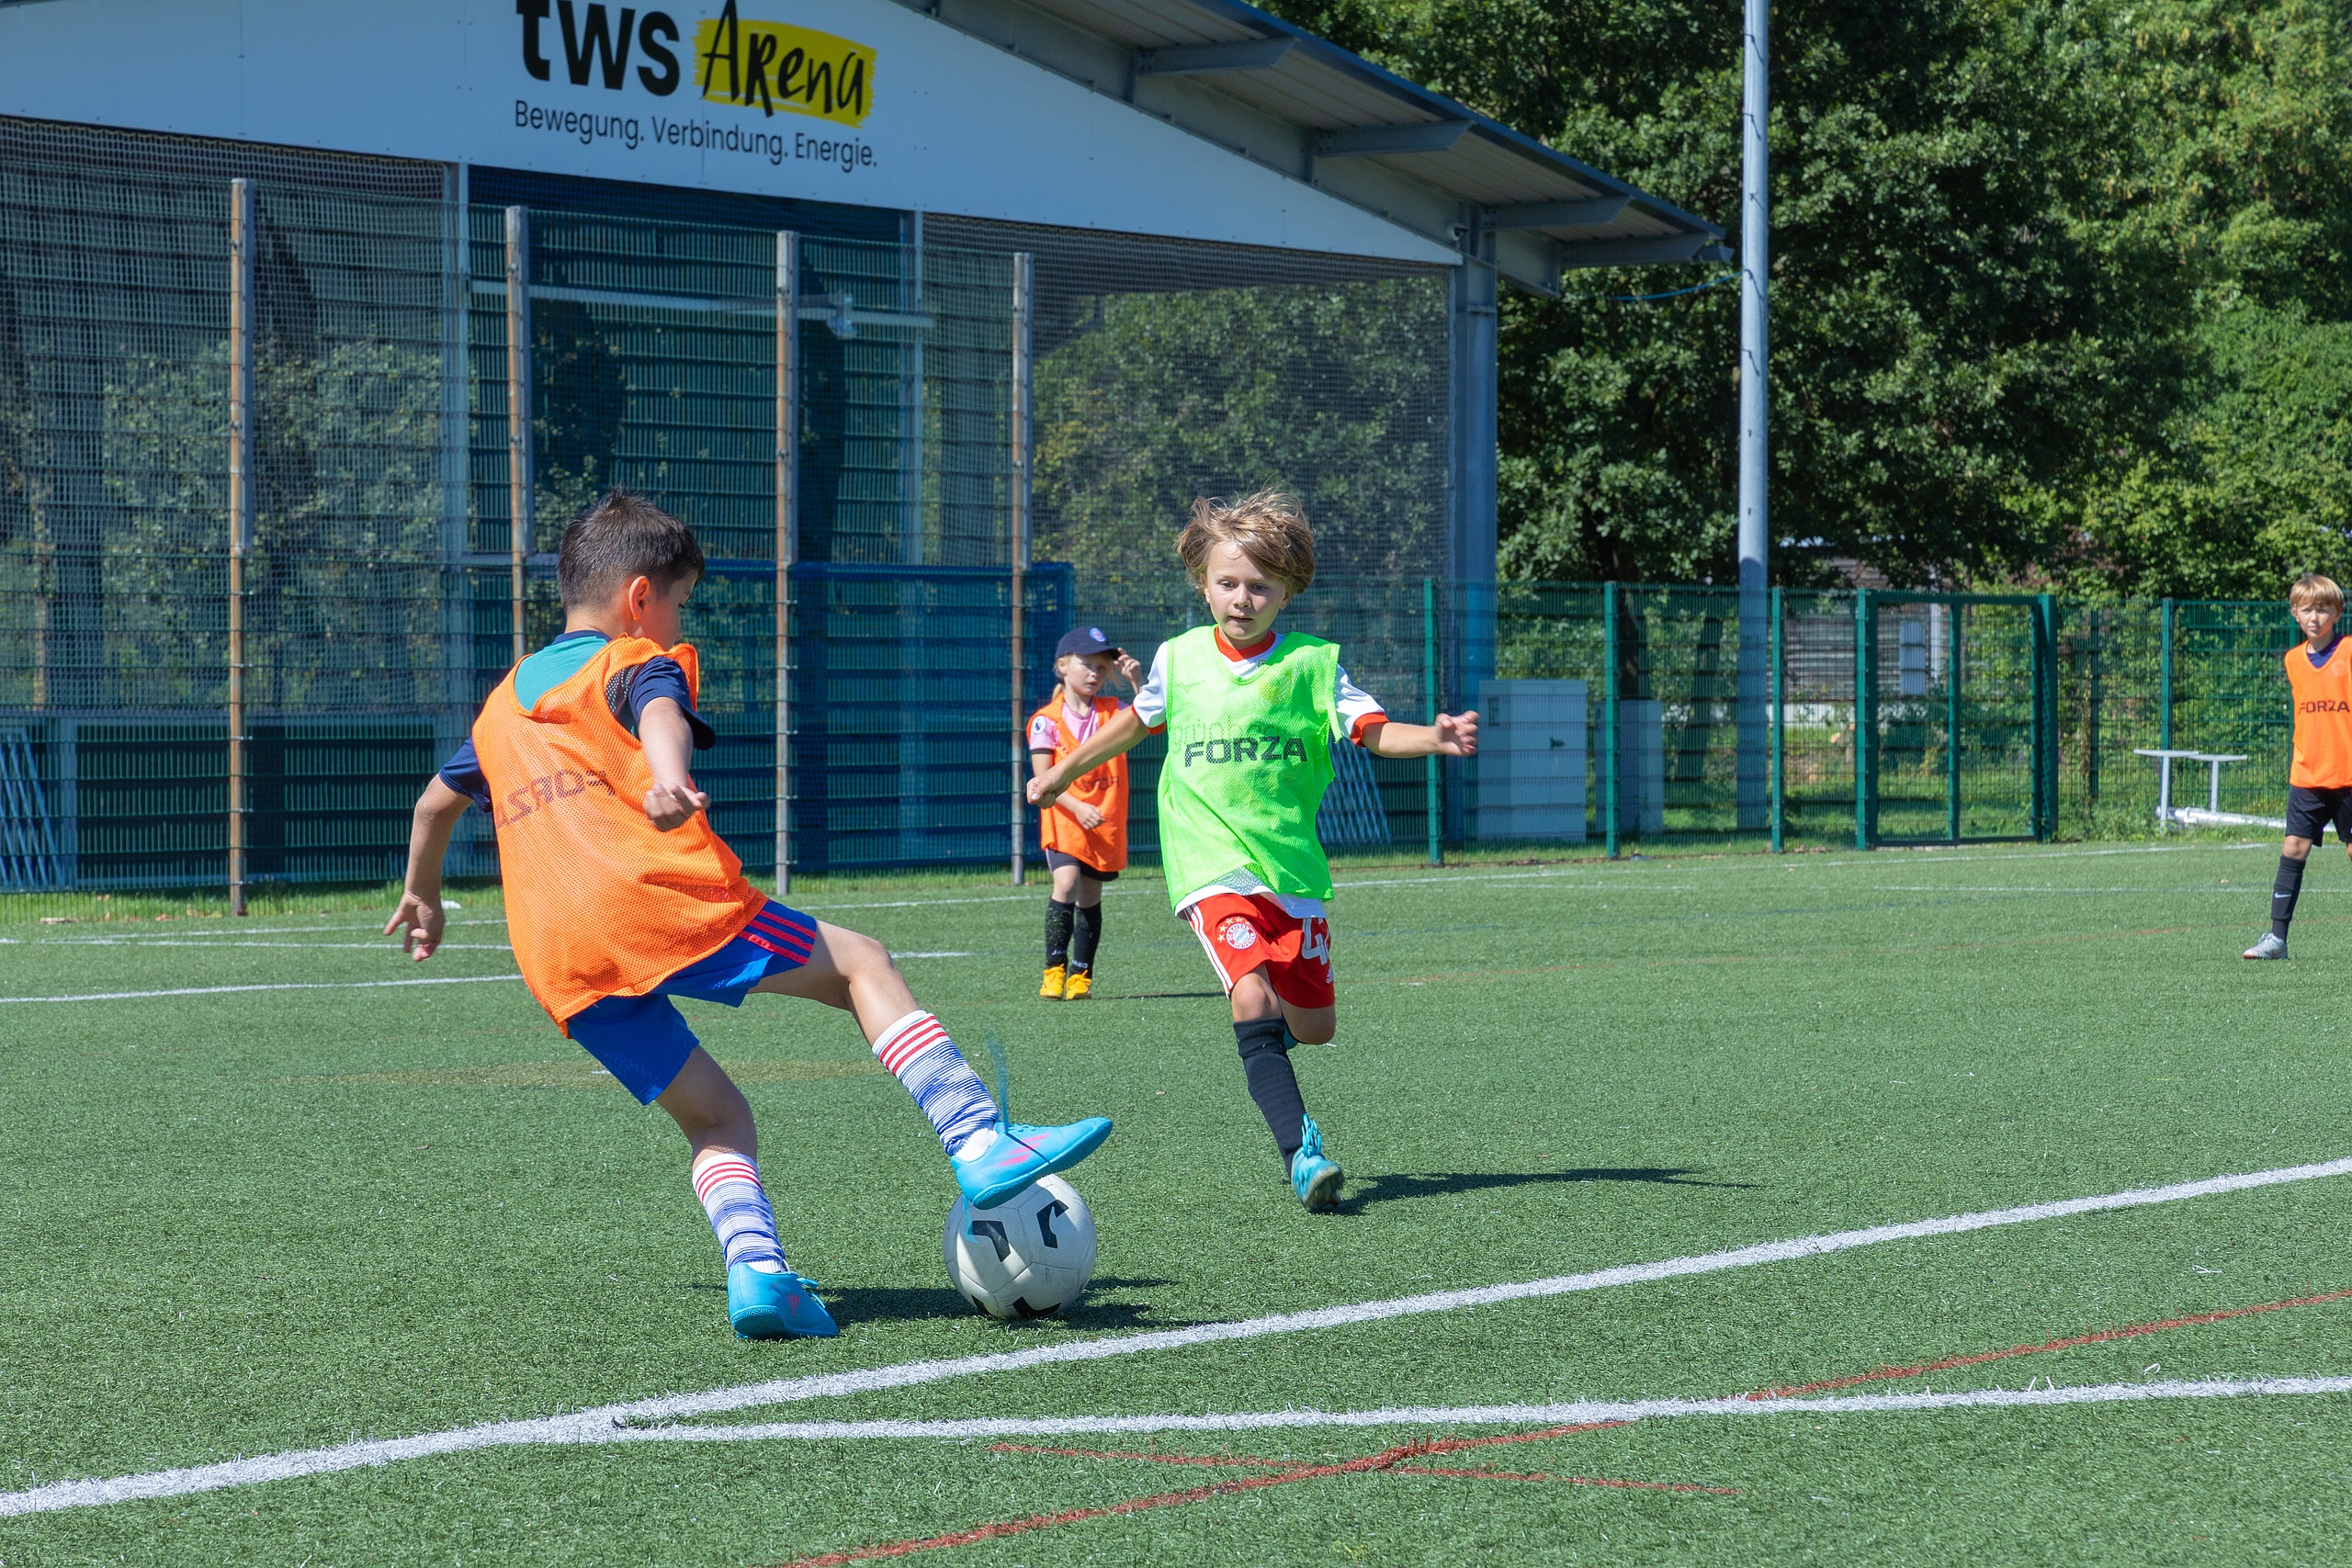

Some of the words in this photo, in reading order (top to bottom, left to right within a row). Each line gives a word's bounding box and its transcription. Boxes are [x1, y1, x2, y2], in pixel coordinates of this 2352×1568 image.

[515, 0, 680, 96] tws
[514, 99, 644, 151] Bewegung.
[651, 116, 788, 165] Verbindung.
[796, 132, 877, 174] Energie.
[2298, 699, 2350, 716] FORZA
[1184, 736, 1308, 768] FORZA
